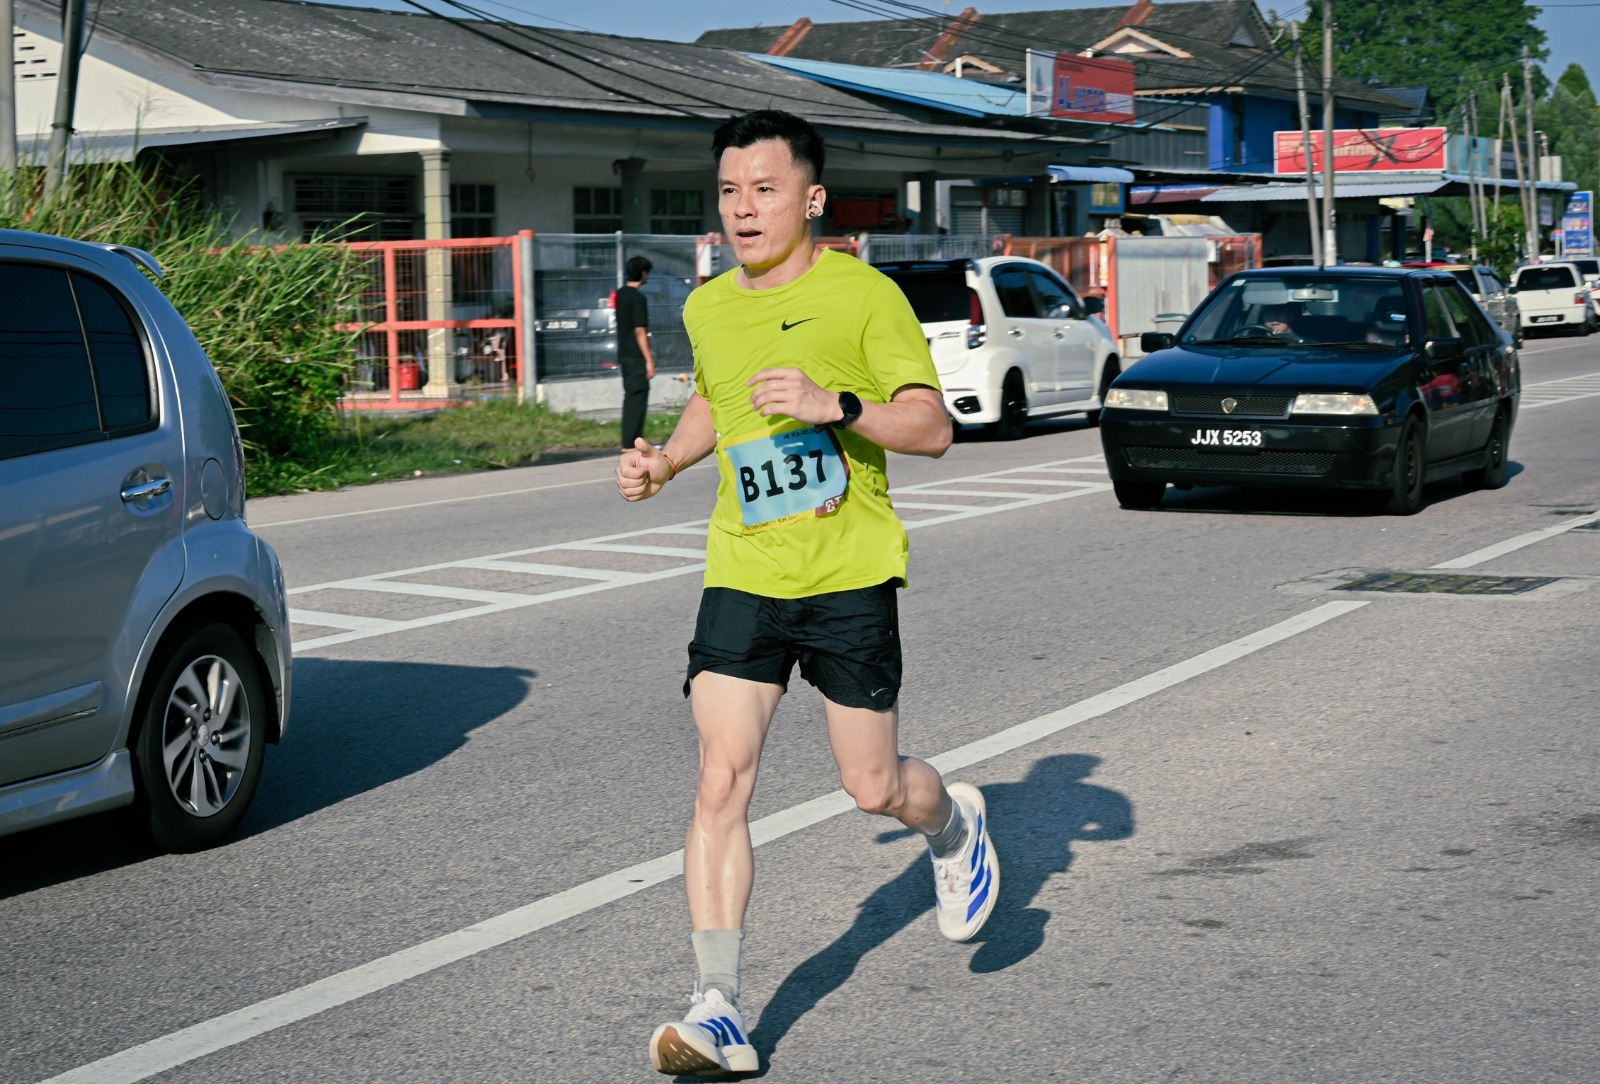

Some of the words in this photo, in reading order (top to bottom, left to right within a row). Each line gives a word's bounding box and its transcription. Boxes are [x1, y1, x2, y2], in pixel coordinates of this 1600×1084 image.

[1191, 429, 1220, 445] JJX
[1223, 430, 1262, 446] 5253
[740, 449, 826, 503] B137
